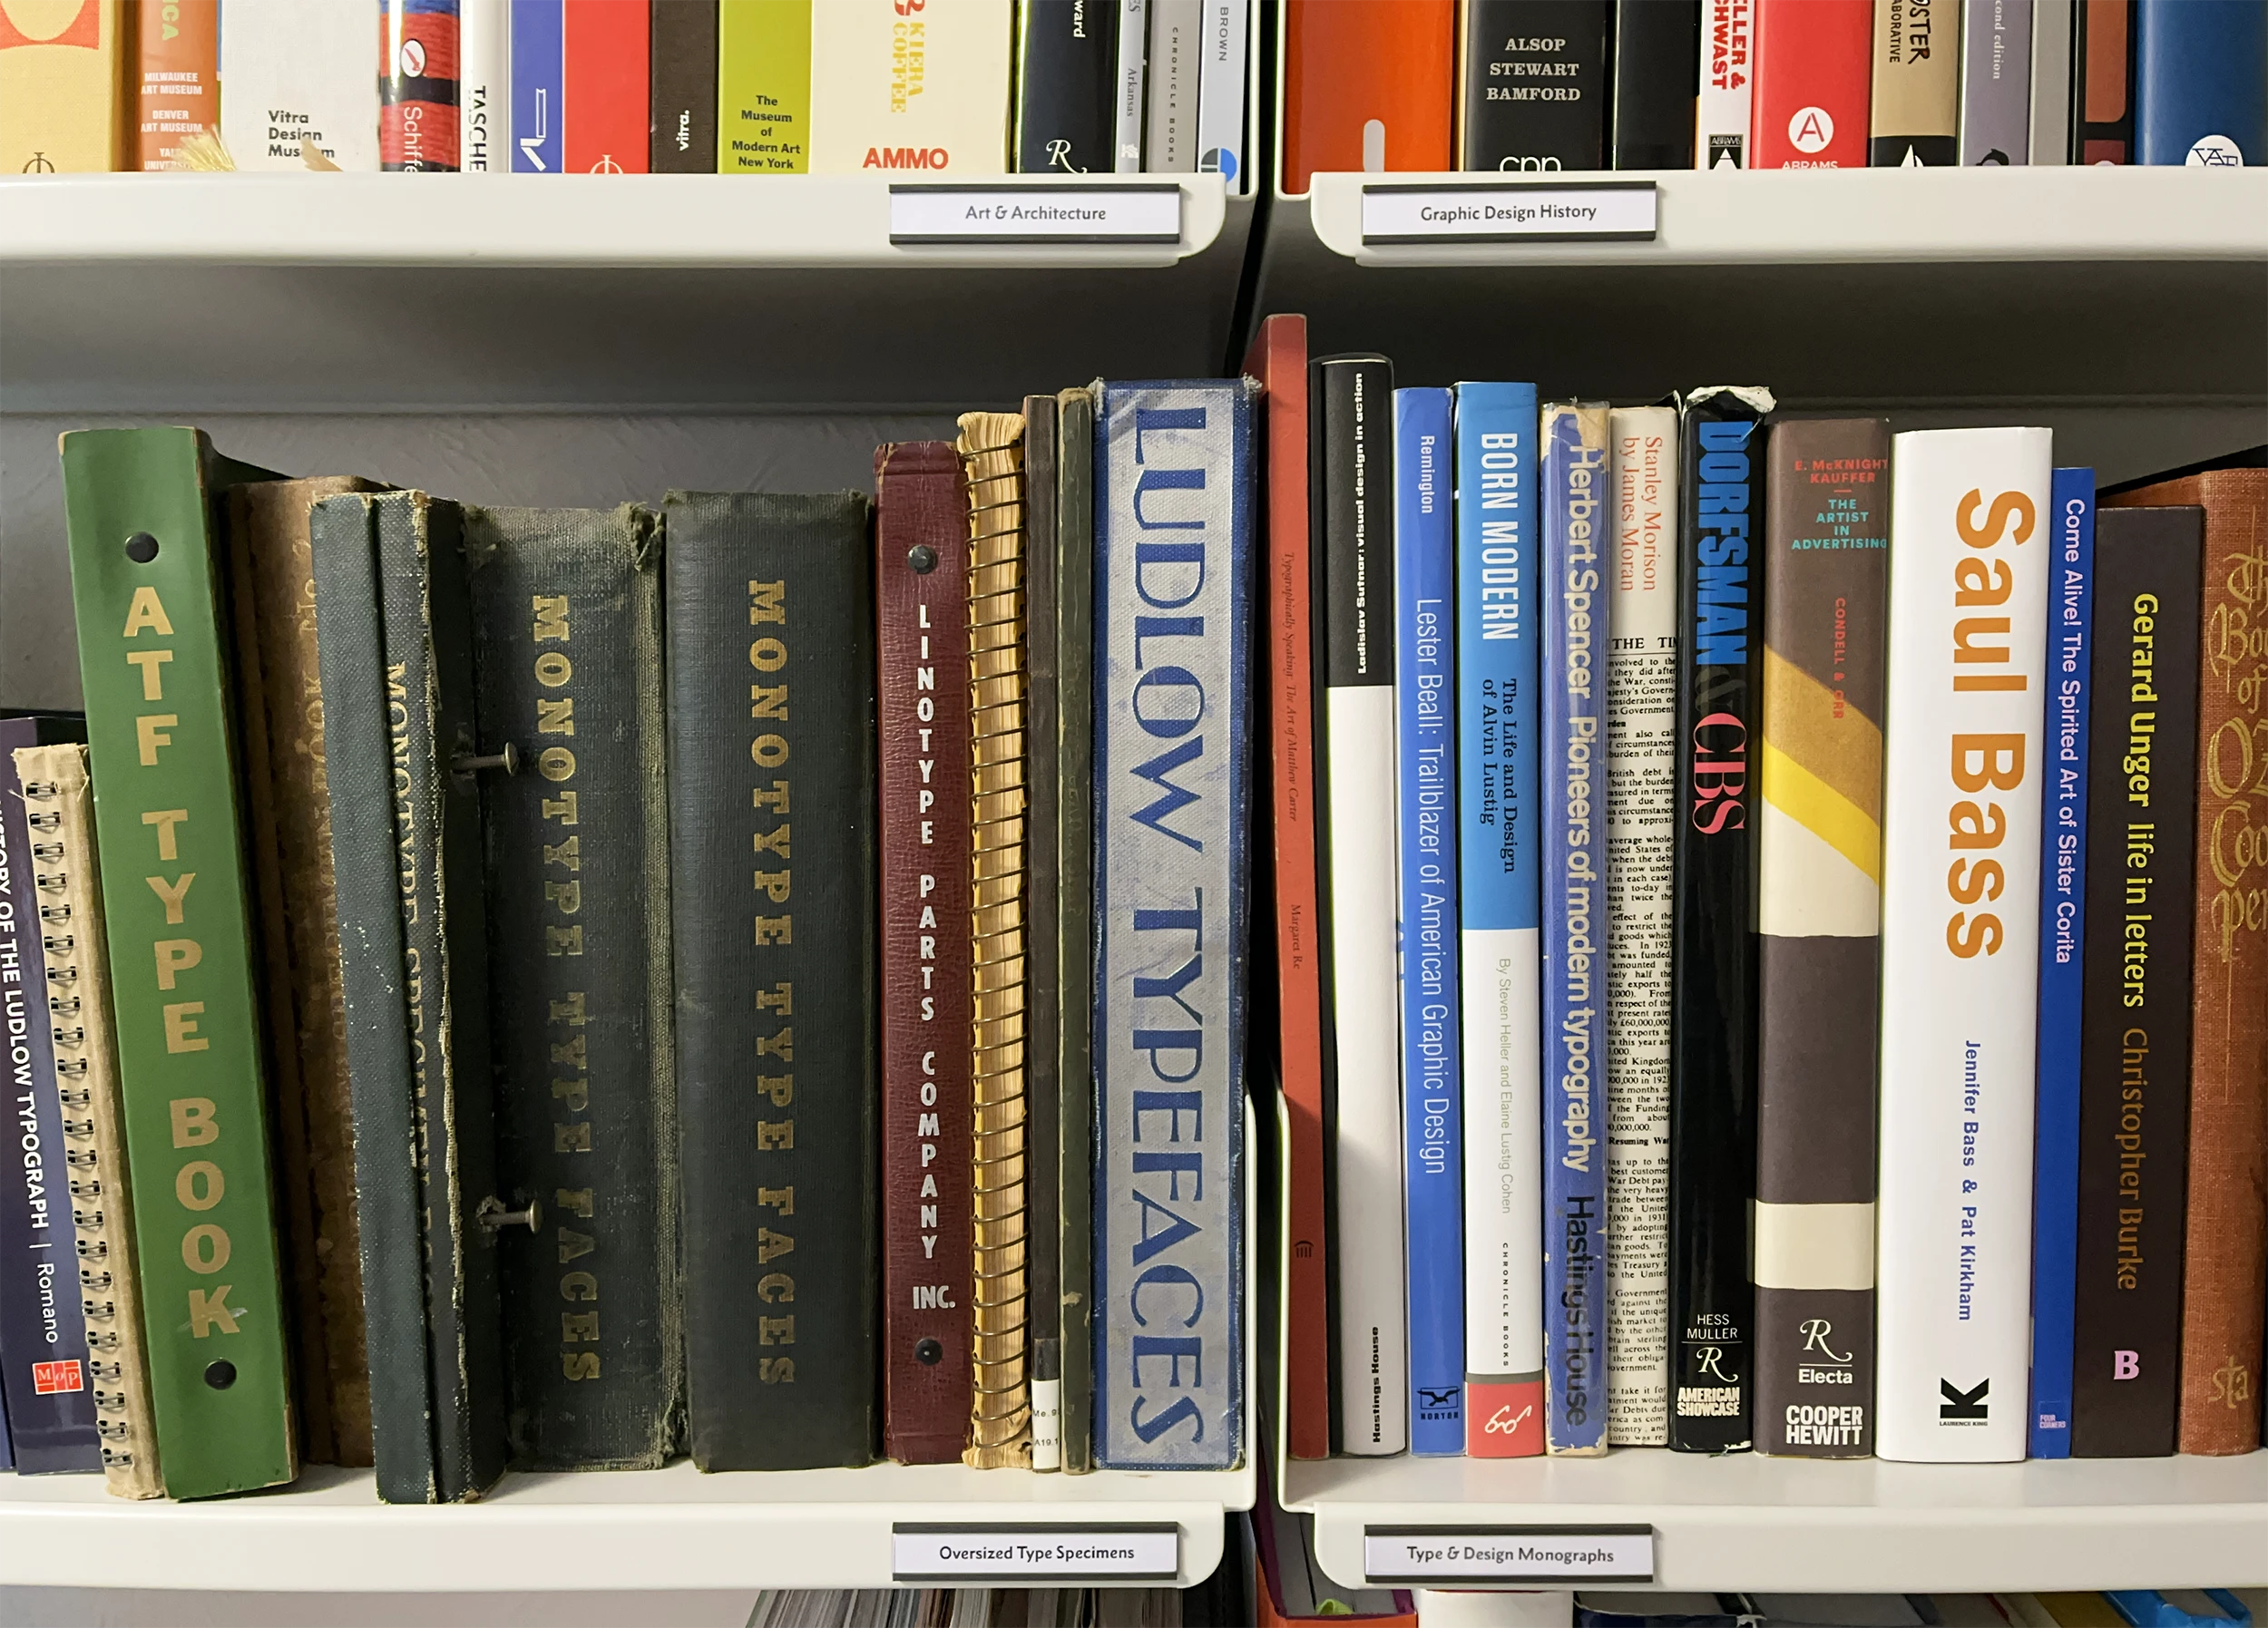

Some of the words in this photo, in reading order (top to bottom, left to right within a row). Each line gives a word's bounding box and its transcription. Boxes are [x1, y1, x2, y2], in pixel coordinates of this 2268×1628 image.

[1168, 26, 1178, 109] CHRONICLE
[1505, 38, 1566, 52] ALSOP
[1992, 34, 2005, 80] edition
[141, 84, 157, 94] ART
[160, 84, 202, 95] MUSEUM
[144, 73, 199, 83] MILWAUKEE
[1490, 63, 1579, 76] STEWART
[152, 110, 189, 120] DENVER
[268, 110, 308, 123] Vitra
[741, 110, 792, 122] Museum
[756, 95, 777, 106] The
[1486, 87, 1581, 101] BAMFORD
[141, 122, 158, 132] ART
[160, 122, 202, 133] MUSEUM
[676, 110, 689, 151] vitra.
[732, 141, 777, 153] Modern
[781, 143, 801, 154] Art
[760, 126, 772, 137] of
[1168, 118, 1176, 162] BOOKS
[738, 156, 764, 168] New
[767, 158, 794, 170] York
[863, 148, 949, 170] AMMO
[965, 205, 990, 219] Art
[995, 205, 1008, 219] &
[1012, 205, 1106, 219] Architecture
[1421, 207, 1480, 223] Graphic
[1485, 206, 1535, 222] Design
[1540, 204, 1597, 221] History
[1354, 373, 1364, 423] action
[1354, 425, 1364, 442] in
[1618, 436, 1640, 461] by
[1354, 443, 1365, 497] design
[1420, 435, 1435, 514] Remington
[1481, 433, 1519, 509] BORN
[1640, 436, 1664, 506] Stanley
[1810, 472, 1875, 483] KAUFFER
[1569, 445, 1598, 564] Herbert
[1621, 465, 1640, 522] James
[1828, 499, 1856, 510] THE
[1355, 500, 1364, 547] visual
[1815, 512, 1869, 523] ARTIST
[1833, 524, 1850, 536] IN
[2064, 498, 2085, 562] Come
[1620, 528, 1640, 591] Moran
[1643, 512, 1662, 590] Morison
[1696, 421, 1753, 665] DORFSMAN
[1280, 551, 1295, 629] Typographically
[1356, 549, 1366, 608] Sutnar:
[1481, 522, 1519, 640] MODERN
[1952, 487, 2036, 691] Saul
[2062, 569, 2082, 628] Alive!
[1129, 407, 1207, 853] LUDLOW
[1356, 610, 1367, 675] Ladislav
[1417, 599, 1442, 666] Lester
[1563, 570, 1598, 697] Spencer
[1612, 638, 1645, 648] THE
[1833, 597, 1846, 665] CONDELL
[2061, 632, 2082, 673] The
[2129, 592, 2159, 702] Gerard
[122, 586, 178, 766] ATF
[1285, 685, 1295, 703] The
[1481, 678, 1498, 698] of
[1502, 678, 1518, 716] The
[1833, 671, 1844, 681] &
[917, 604, 935, 844] LINOTYPE
[1285, 704, 1296, 722] Art
[1417, 674, 1443, 736] Beall:
[1833, 689, 1844, 719] ORR
[2057, 679, 2081, 761] Spirited
[1286, 723, 1297, 735] of
[1482, 704, 1498, 756] Alvin
[1502, 721, 1519, 758] Life
[533, 595, 583, 957] MONOTYPE
[748, 580, 793, 946] MONOTYPE
[1286, 735, 1298, 785] Matthew
[1567, 717, 1598, 846] Pioneers
[1693, 712, 1746, 834] CBS
[2123, 710, 2155, 807] Unger
[1287, 787, 1298, 822] Carter
[1417, 743, 1444, 856] Trailblazer
[1480, 763, 1499, 826] Lustig
[1503, 764, 1518, 801] and
[2059, 767, 2078, 800] Art
[1500, 806, 1518, 873] Design
[2058, 804, 2077, 830] of
[1568, 851, 1598, 882] of
[1946, 732, 2026, 959] Bass
[2057, 832, 2077, 895] Sister
[2127, 824, 2154, 870] life
[1421, 863, 1445, 885] of
[2126, 877, 2153, 906] in
[142, 808, 210, 1055] TYPE
[919, 874, 937, 1021] PARTS
[1289, 903, 1302, 952] Margaret
[1420, 892, 1447, 996] American
[1567, 887, 1597, 1003] modern
[2056, 901, 2076, 963] Corita
[1291, 955, 1302, 971] Re
[1496, 958, 1511, 980] By
[2123, 913, 2152, 1009] letters
[1499, 980, 1512, 1021] Steven
[1628, 980, 1660, 989] exports
[5, 989, 33, 1087] LUDLOW
[1417, 1004, 1449, 1089] Graphic
[1500, 1025, 1512, 1063] Heller
[549, 992, 593, 1152] TYPE
[756, 982, 794, 1151] TYPE
[1501, 1067, 1512, 1088] and
[1963, 1039, 1981, 1115] Jennifer
[1501, 1093, 1512, 1129] Elaine
[1560, 1007, 1597, 1173] typography
[1423, 1097, 1452, 1175] Design
[2115, 1028, 2149, 1201] Christopher
[17, 1090, 50, 1229] TYPOGRAPH
[917, 1051, 940, 1259] COMPANY
[1499, 1134, 1513, 1170] Lustig
[1608, 1137, 1648, 1146] Resuming
[1962, 1121, 1980, 1167] Bass
[1129, 886, 1205, 1446] TYPEFACES
[1961, 1178, 1978, 1194] &
[170, 1097, 240, 1339] BOOK
[1501, 1175, 1514, 1215] Cohen
[1961, 1206, 1978, 1237] Pat
[1559, 1194, 1597, 1326] Hastings
[2117, 1207, 2143, 1291] Burke
[36, 1262, 58, 1345] Romano
[556, 1188, 600, 1381] FACES
[758, 1186, 796, 1385] FACES
[913, 1286, 955, 1310] INC.
[1959, 1244, 1977, 1321] Kirkham
[1686, 1328, 1738, 1339] MULLER
[1696, 1314, 1730, 1325] HESS
[1371, 1326, 1380, 1364] House
[1564, 1332, 1597, 1427] House
[1677, 1387, 1740, 1402] AMERICAN
[1798, 1369, 1853, 1384] Electa
[1372, 1366, 1383, 1443] Hastings
[1677, 1402, 1740, 1417] SHOWCASE
[1786, 1405, 1863, 1426] COOPER
[1785, 1425, 1862, 1446] HEWITT
[939, 1545, 1013, 1560] Oversized
[1017, 1545, 1052, 1564] Type
[1056, 1545, 1135, 1564] Specimens
[1406, 1545, 1443, 1563] Type
[1447, 1545, 1460, 1558] &
[1463, 1547, 1514, 1563] Design
[1518, 1547, 1614, 1565] Monographs
